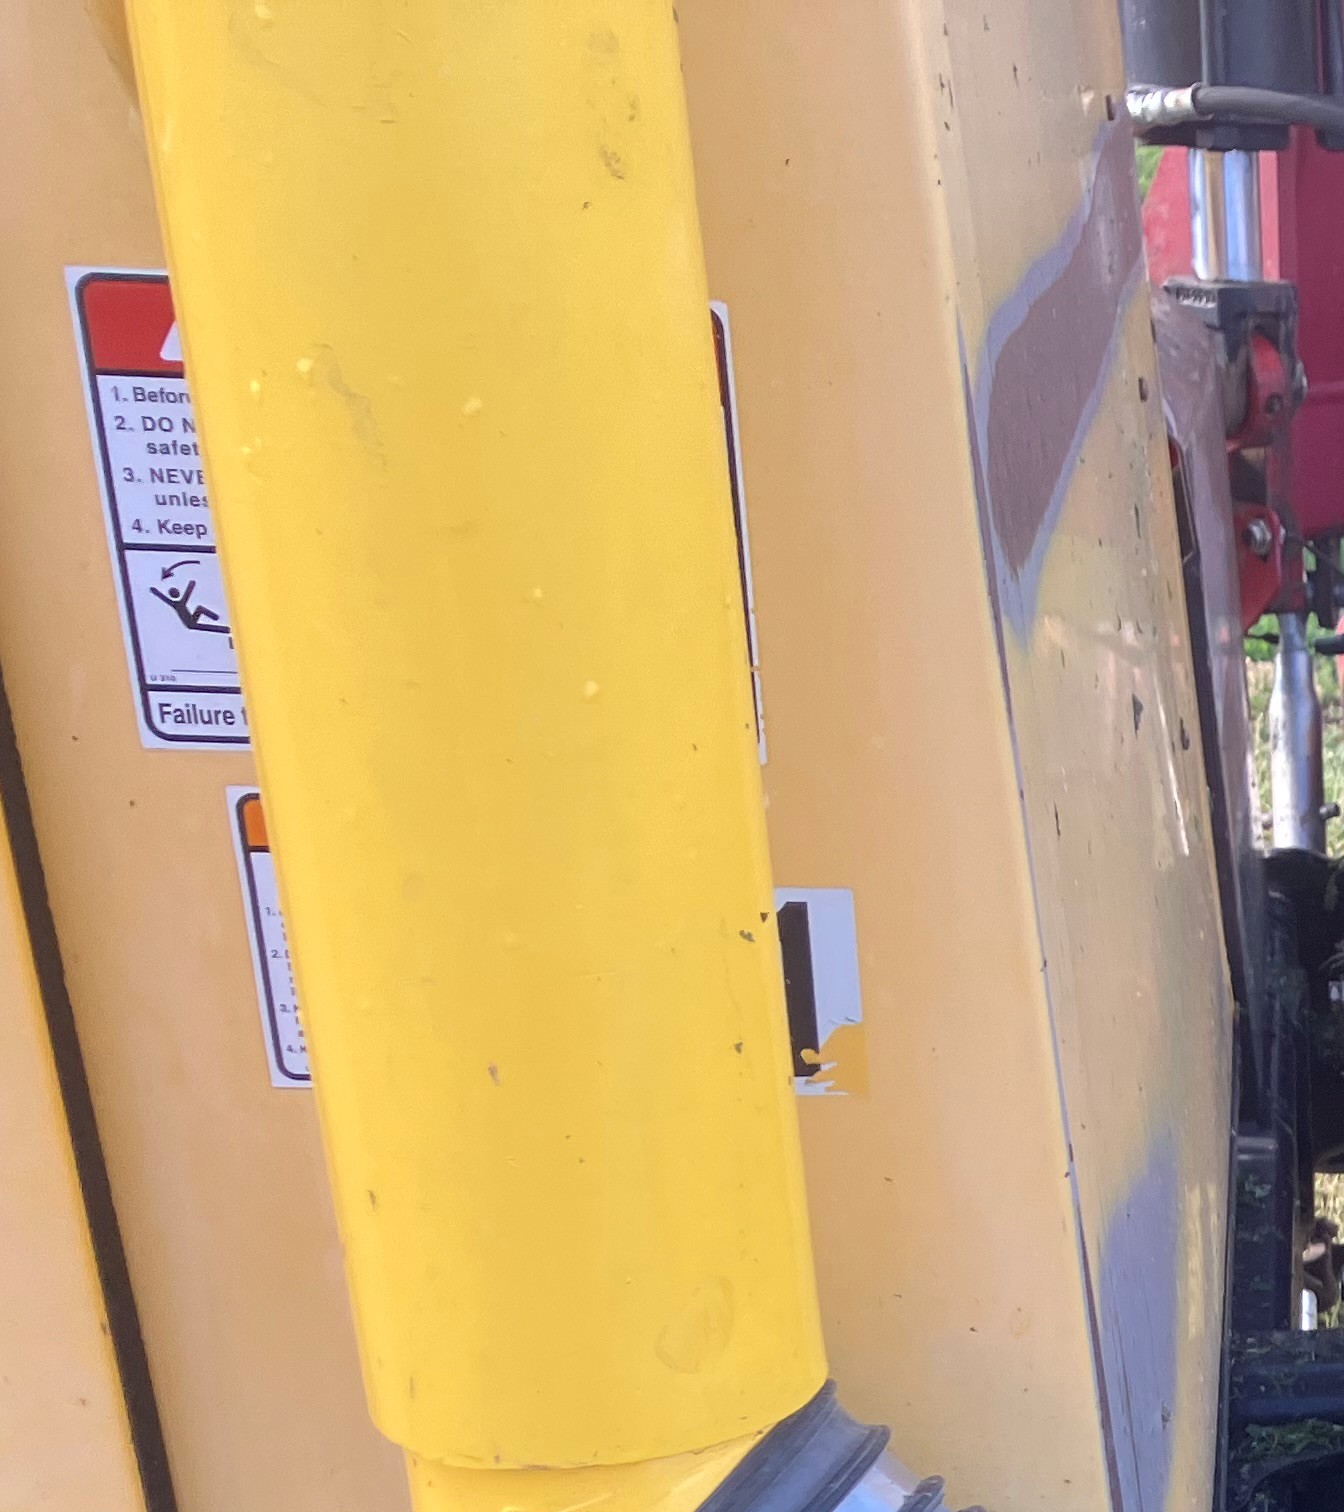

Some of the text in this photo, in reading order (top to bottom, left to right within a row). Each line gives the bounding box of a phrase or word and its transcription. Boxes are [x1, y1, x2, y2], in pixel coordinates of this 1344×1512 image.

[111, 385, 129, 402] 1.
[114, 415, 197, 433] 2. DO N
[146, 439, 199, 456] safet
[122, 467, 205, 485] 3. NEVE
[154, 491, 209, 508] unles
[132, 518, 208, 540] 4. Keep
[158, 703, 236, 726] Failure
